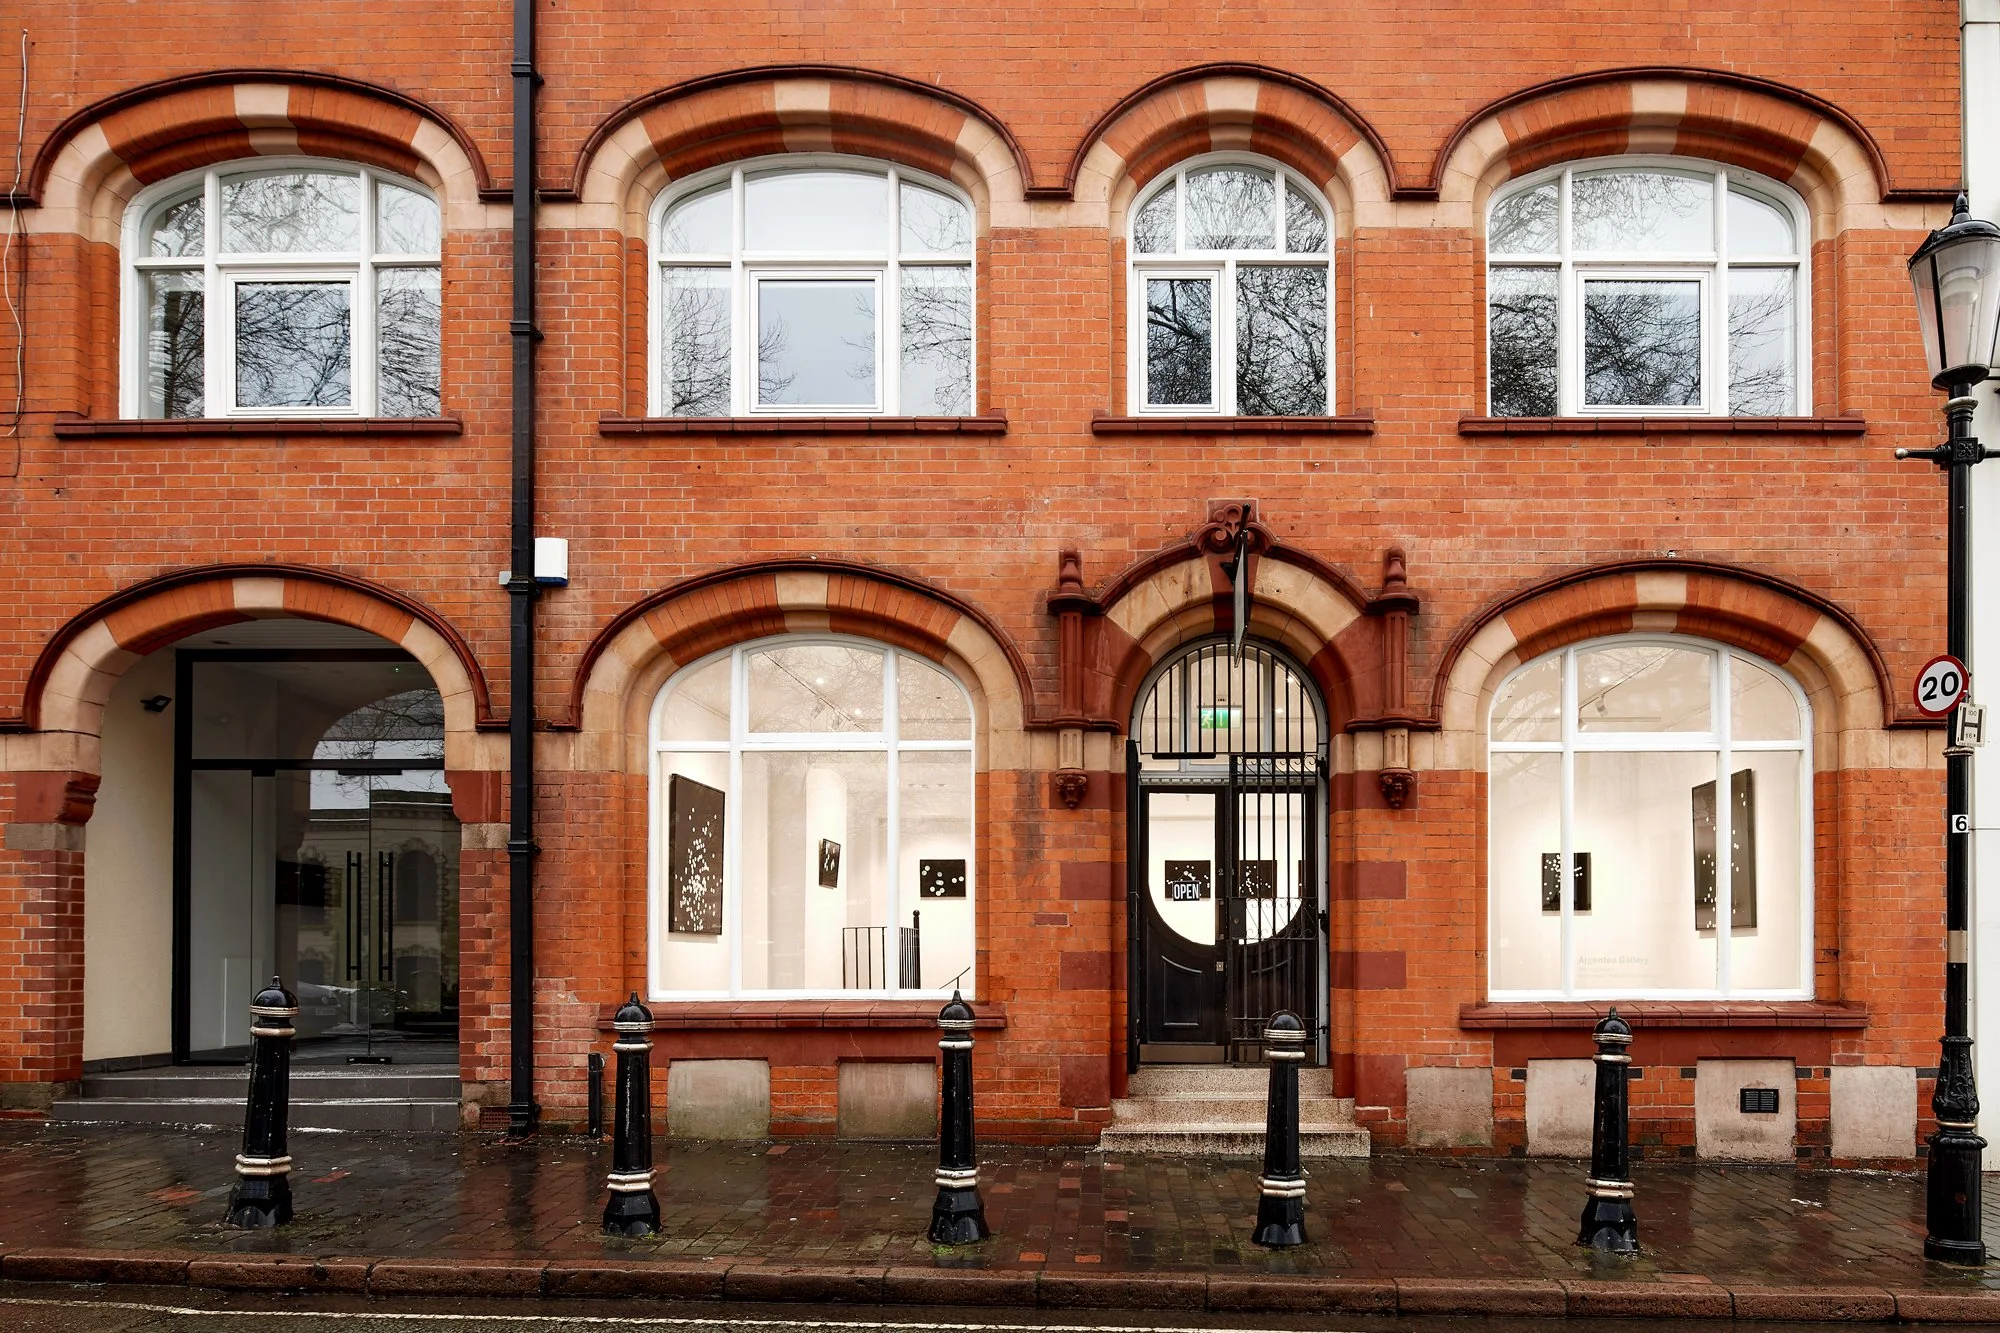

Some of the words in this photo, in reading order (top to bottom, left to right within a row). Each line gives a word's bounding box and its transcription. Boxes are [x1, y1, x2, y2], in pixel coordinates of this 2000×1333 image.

[1922, 671, 1959, 702] 20
[1960, 707, 1983, 743] H
[1955, 815, 1967, 831] 6
[1174, 883, 1199, 899] OPEN
[1578, 956, 1617, 965] Argentea
[1618, 956, 1649, 965] Gallery
